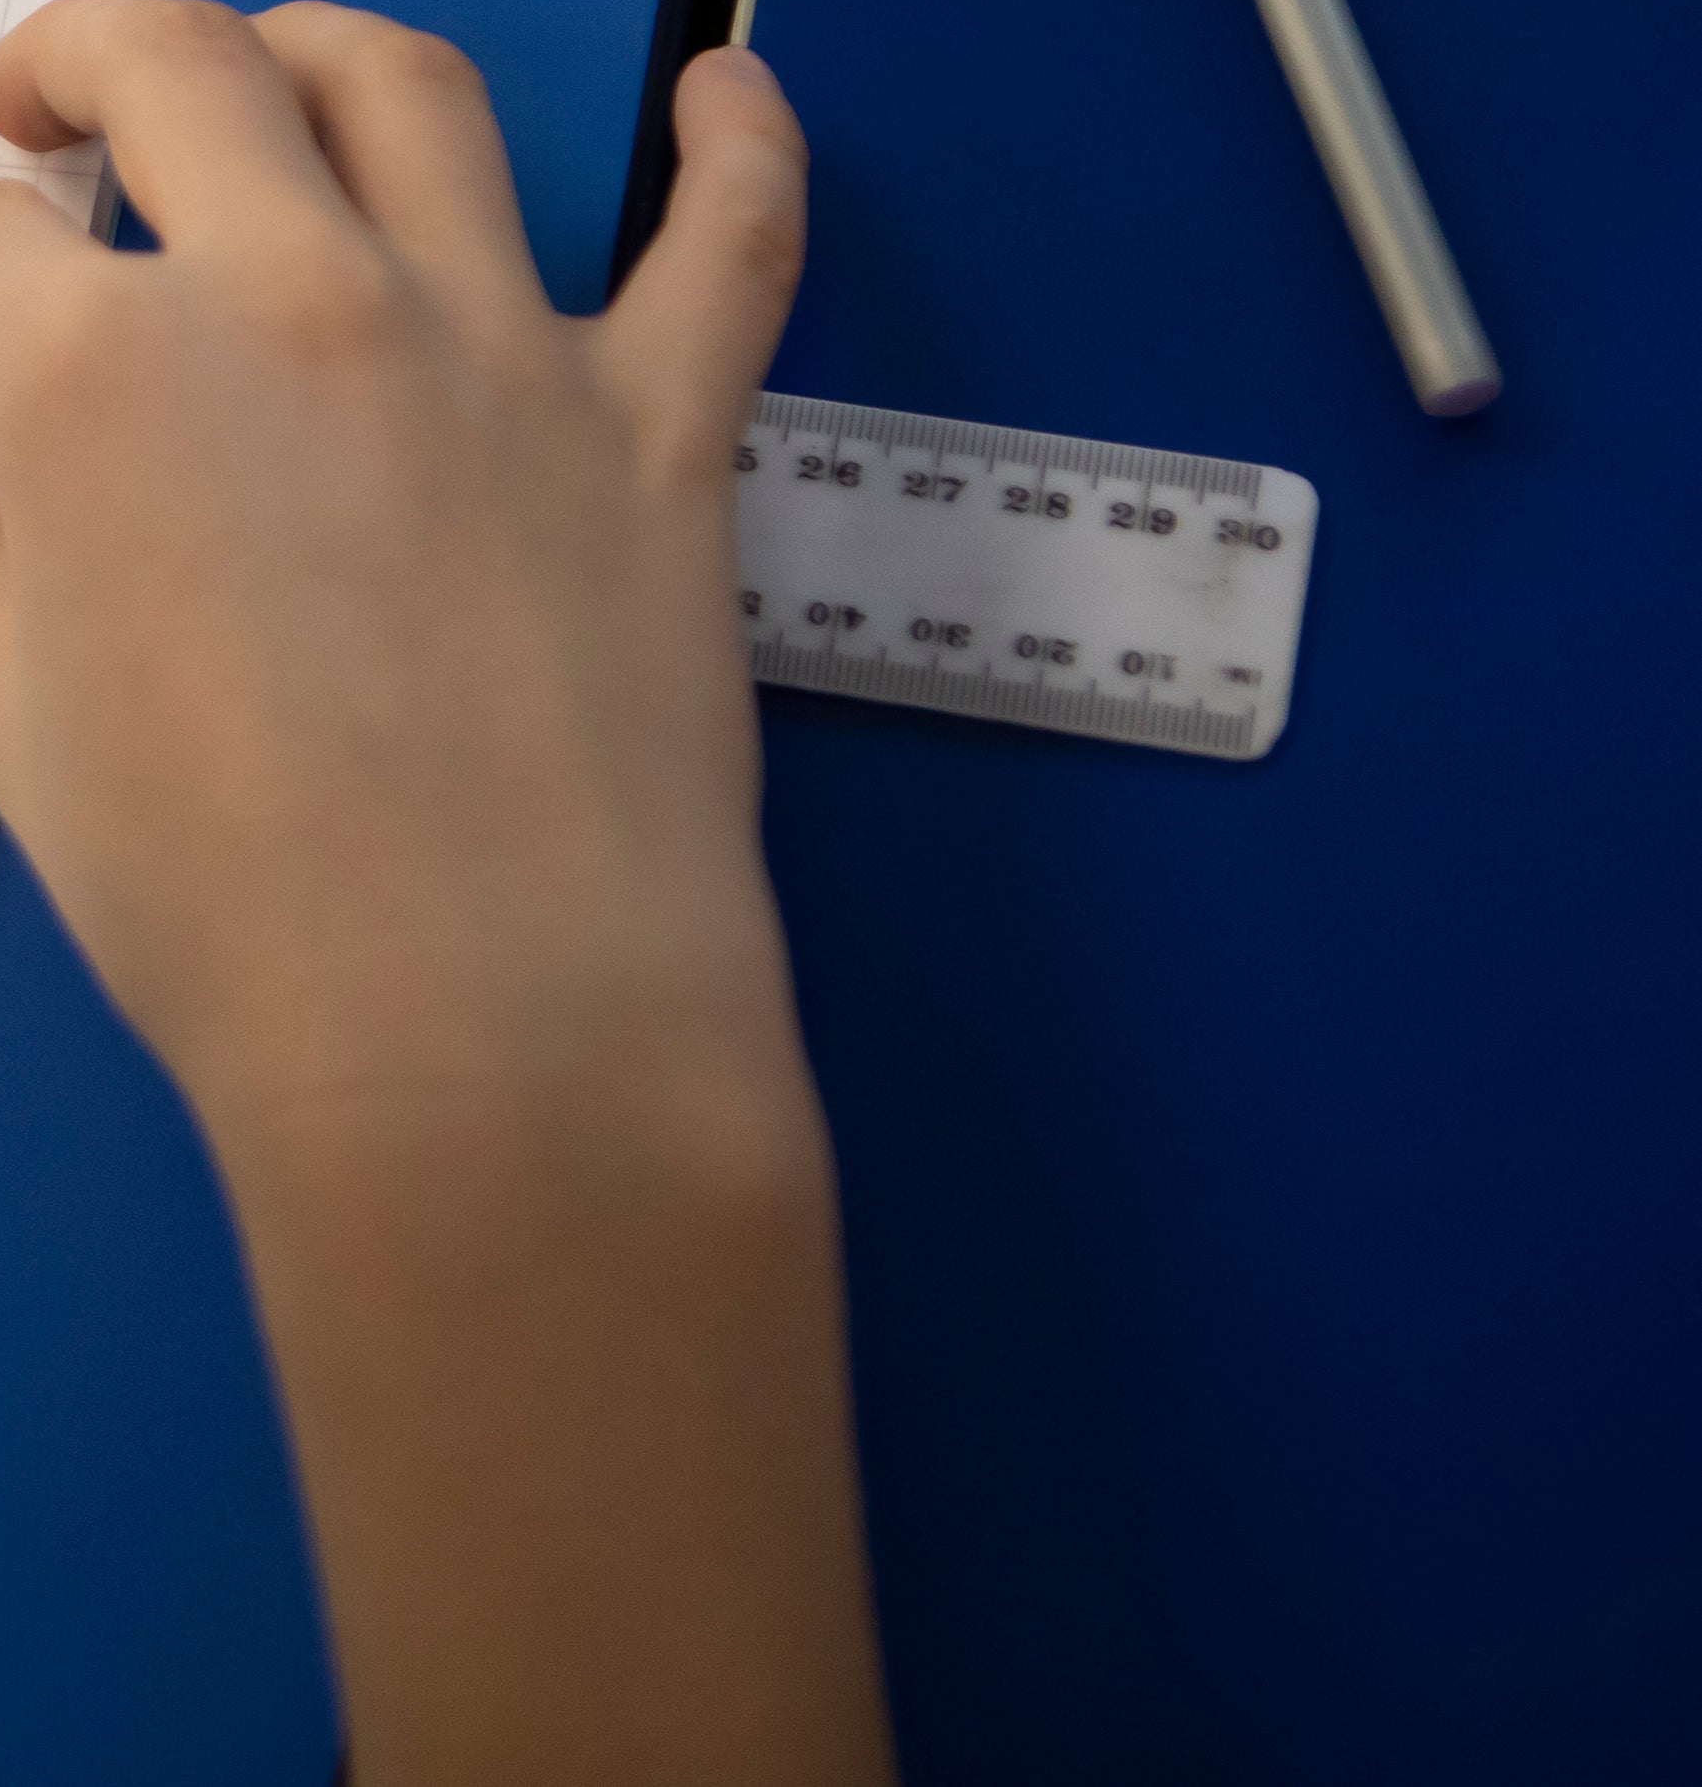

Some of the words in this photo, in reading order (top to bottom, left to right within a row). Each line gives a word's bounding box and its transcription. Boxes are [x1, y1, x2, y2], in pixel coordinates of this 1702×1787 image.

[734, 445, 759, 473] 5
[797, 455, 862, 488] 26
[902, 471, 966, 504] 27
[1003, 486, 1073, 520] 28
[1108, 501, 1177, 535] 29
[1216, 518, 1281, 552] 30
[739, 590, 763, 617] 5
[807, 601, 866, 631] 40
[910, 617, 972, 648] 30
[1013, 634, 1078, 666] 20
[1120, 650, 1178, 682] 10
